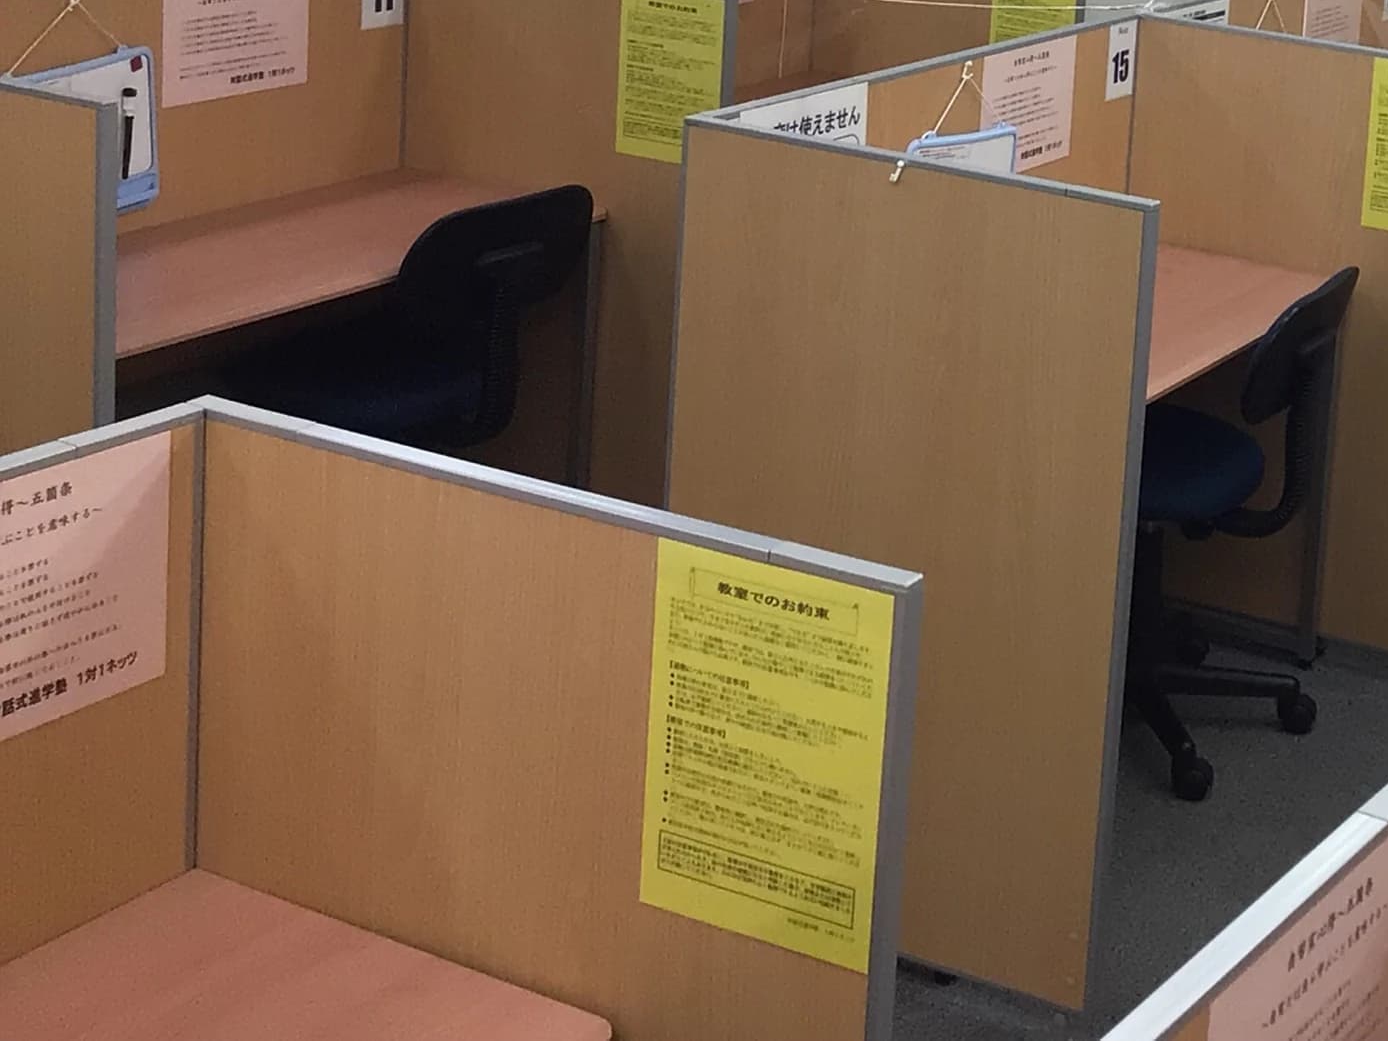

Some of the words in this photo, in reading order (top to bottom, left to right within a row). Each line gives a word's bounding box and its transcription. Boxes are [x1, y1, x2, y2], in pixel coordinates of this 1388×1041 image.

[1112, 50, 1130, 84] 15
[716, 580, 831, 622] 教室でのお約束
[76, 650, 138, 687] 1対1ネッツ
